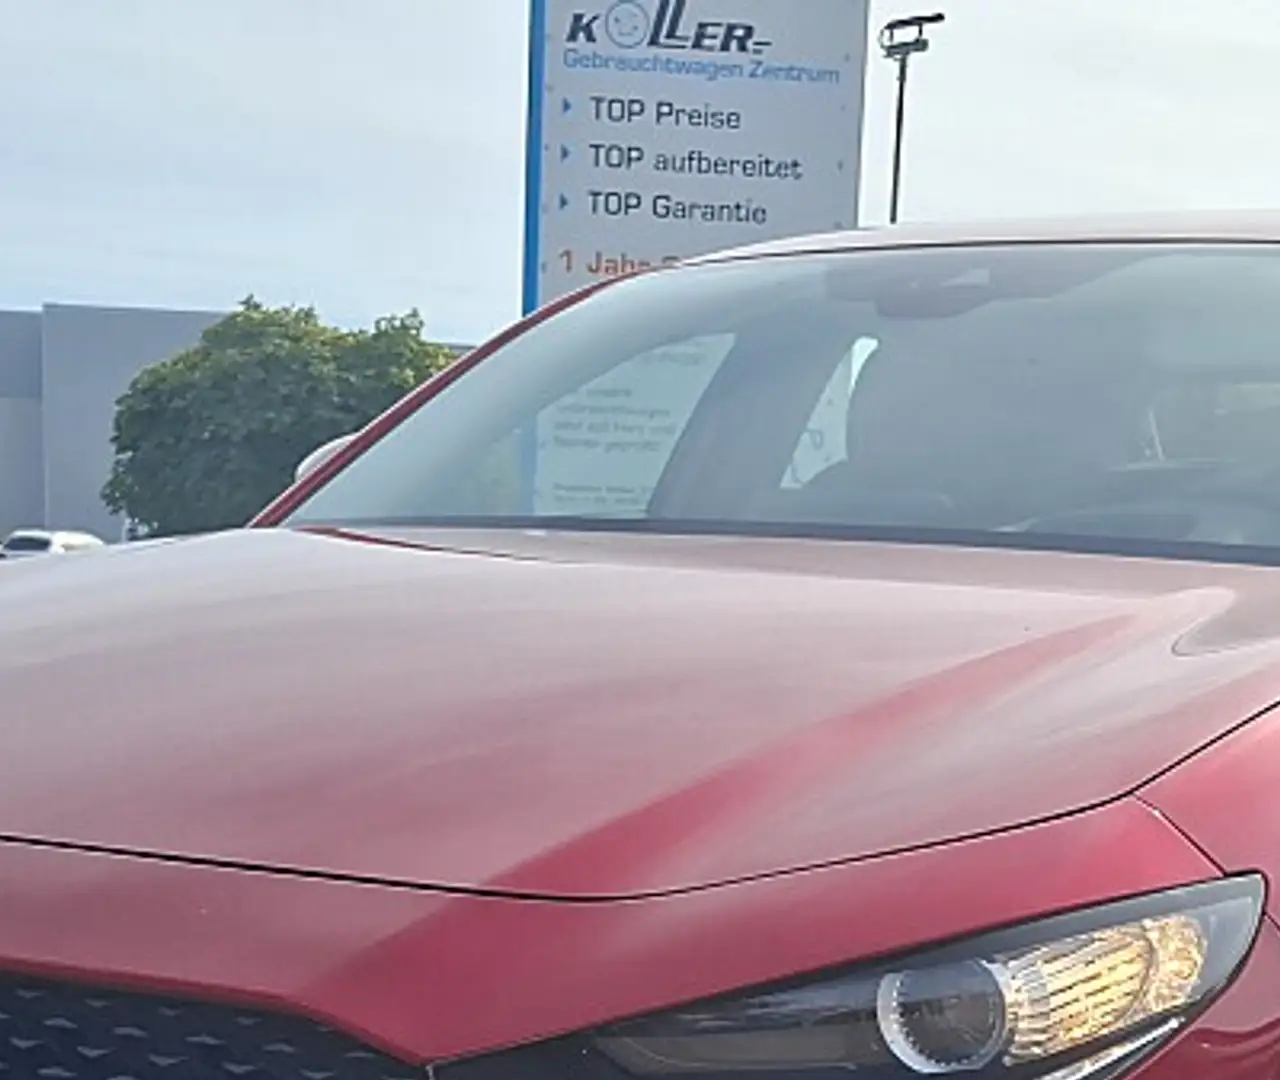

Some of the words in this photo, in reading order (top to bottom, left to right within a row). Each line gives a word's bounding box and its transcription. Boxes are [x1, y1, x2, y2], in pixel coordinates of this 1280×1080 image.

[563, 48, 743, 80] Gebrauchtwagen
[748, 60, 840, 84] Zentrum
[590, 96, 645, 123] TOP
[655, 101, 741, 129] Preise
[589, 144, 644, 170] TOP
[653, 151, 803, 180] aufbereitet
[588, 191, 642, 217] TOP
[652, 195, 767, 225] Garantie
[559, 249, 574, 274] 1
